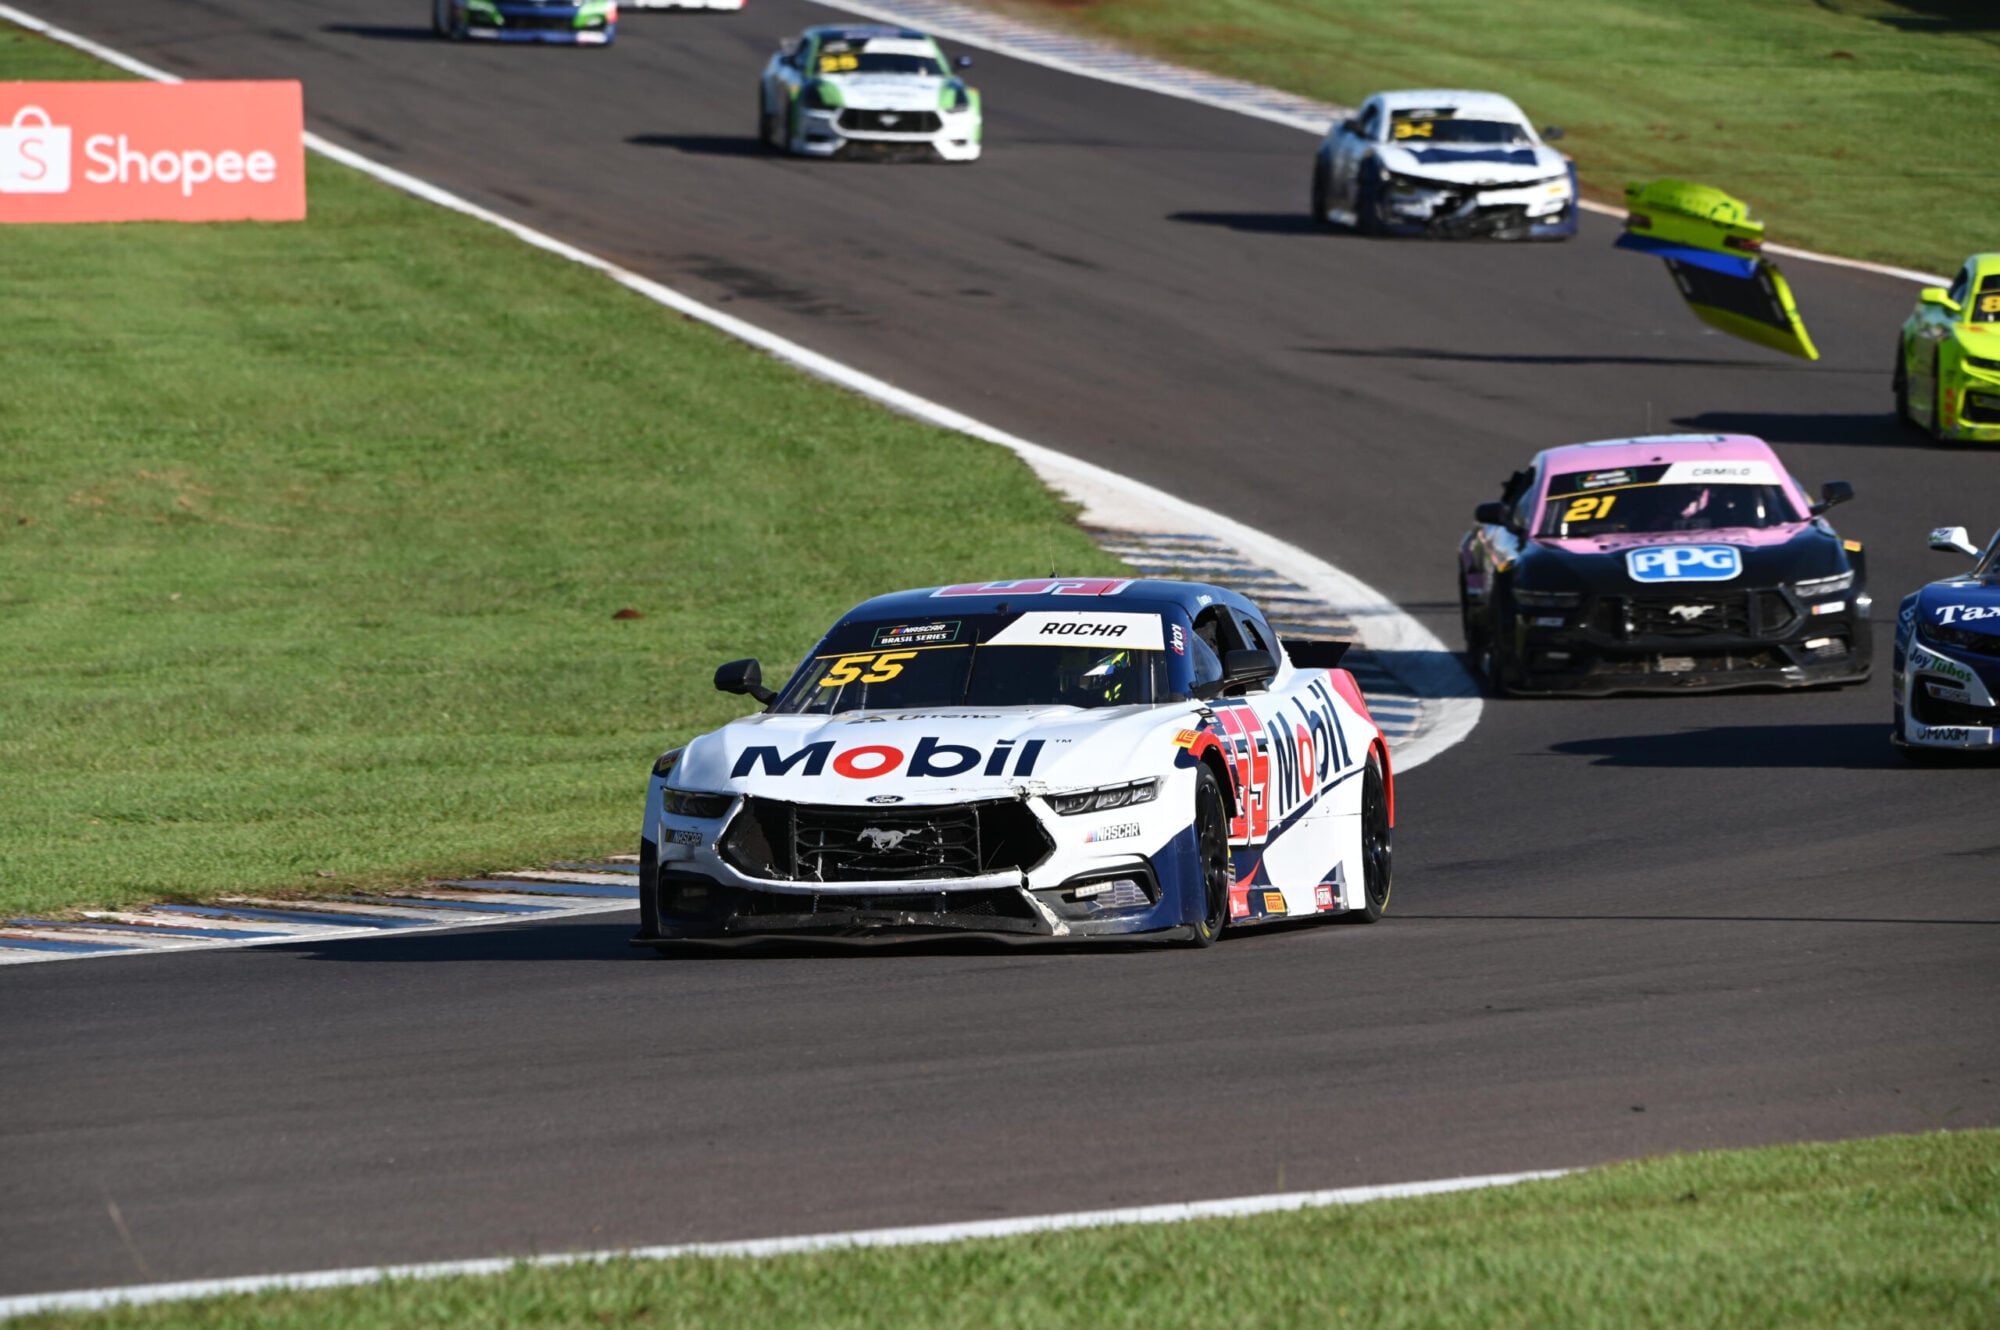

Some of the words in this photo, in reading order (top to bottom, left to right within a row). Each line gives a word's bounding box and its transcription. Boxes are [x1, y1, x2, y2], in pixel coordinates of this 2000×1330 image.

[84, 133, 277, 197] Shopee
[1692, 467, 1751, 477] CAMILO
[1563, 495, 1617, 522] 21
[1635, 548, 1734, 577] PPG
[881, 635, 913, 645] BRASIL
[916, 632, 948, 642] SERIES
[903, 624, 946, 634] NASCAR
[1039, 622, 1128, 638] ROCHA
[819, 651, 919, 687] 55
[1909, 647, 1932, 669] Joy
[1930, 654, 1973, 682] Tubos
[730, 737, 1046, 780] Mobil
[1267, 678, 1353, 817] Mobil
[1098, 822, 1141, 841] NASCAR
